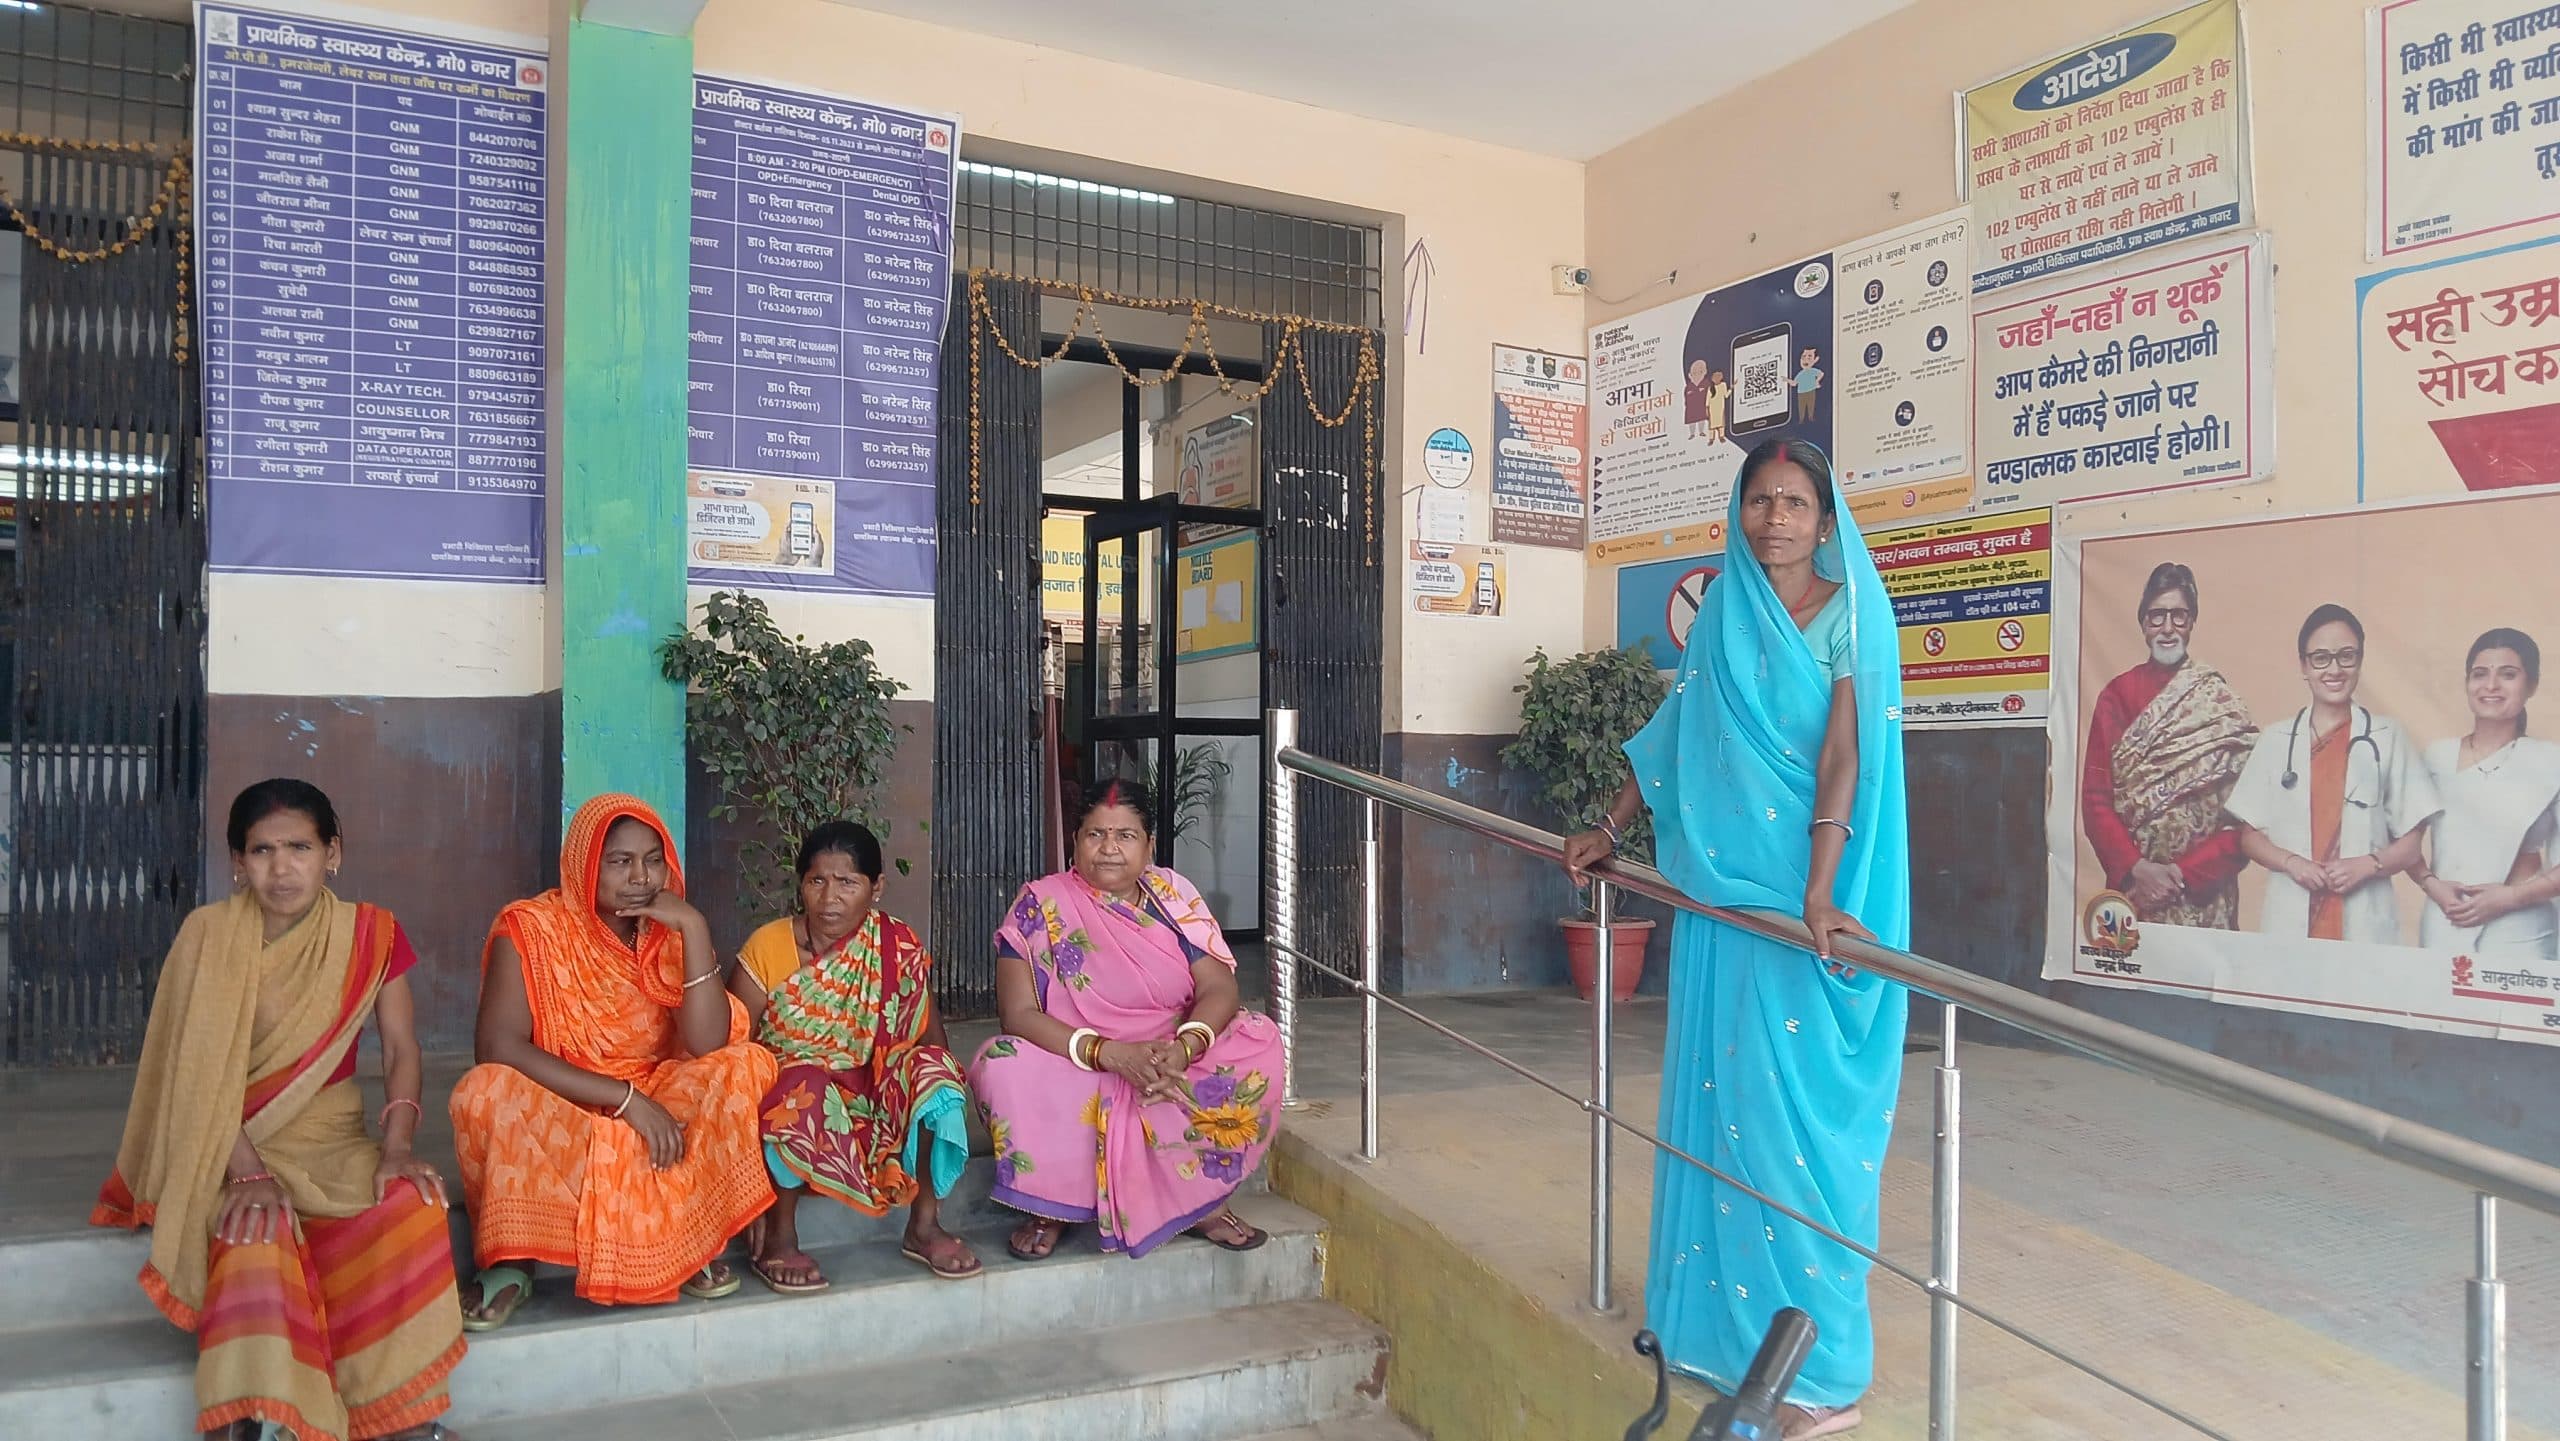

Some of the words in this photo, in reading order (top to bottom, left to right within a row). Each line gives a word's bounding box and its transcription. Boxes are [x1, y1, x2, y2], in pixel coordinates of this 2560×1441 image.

[246, 25, 318, 48] प्राथमिक
[322, 37, 382, 59] स्वास्थ्य
[471, 60, 511, 79] नगर
[2400, 32, 2453, 76] किसी
[2460, 22, 2486, 55] भी
[2042, 47, 2130, 105] आदेश
[2402, 82, 2422, 116] में
[2427, 68, 2481, 111] किसी
[2489, 57, 2515, 92] भी
[700, 89, 762, 112] प्राथमिक
[765, 97, 816, 122] स्वास्थ्य
[890, 123, 924, 141] नगर
[1972, 138, 1997, 161] सभी
[2001, 118, 2050, 153] आशाओं
[2055, 113, 2073, 133] को
[2078, 101, 2113, 126] निर्देश
[2119, 87, 2149, 112] दिया
[2154, 75, 2188, 99] जाता
[2192, 65, 2205, 86] है
[2210, 58, 2232, 81] कि
[389, 120, 420, 134] GNM
[2406, 124, 2436, 159] की
[2441, 113, 2484, 149] मांग
[2489, 101, 2522, 136] की
[1976, 164, 2003, 189] प्रसव
[2008, 158, 2020, 176] के
[2076, 134, 2093, 154] को
[2101, 126, 2129, 147] 102
[2192, 97, 2204, 117] से
[2211, 88, 2227, 111] ही
[299, 153, 323, 166] शर्मा
[389, 164, 420, 178] GNM
[768, 156, 784, 167] AM
[791, 159, 810, 171] 2:00
[811, 162, 826, 174] PM
[827, 166, 913, 190] (OPD-EMERGENCY)
[2019, 183, 2035, 200] घर
[2040, 176, 2051, 194] से
[2113, 152, 2127, 172] ले
[757, 170, 833, 192] OPD+Emergency
[769, 193, 793, 211] दिया
[872, 189, 899, 202] Dental
[901, 194, 921, 206] OPD
[1985, 221, 2010, 239] 102
[2065, 197, 2077, 216] से
[2081, 185, 2107, 210] नहीं
[2111, 179, 2139, 201] लाने
[2145, 173, 2161, 191] या
[2166, 166, 2181, 186] ले
[2187, 156, 2218, 179] जाने
[290, 219, 325, 233] कुमारी
[758, 210, 824, 228] (7632067800)
[914, 216, 933, 231] सिंह
[2001, 244, 2016, 261] पर
[2021, 226, 2070, 258] प्रोत्साहन
[2076, 218, 2104, 241] राशि
[2139, 193, 2184, 223] मिलेगी
[2209, 210, 2232, 226] नगर
[867, 226, 930, 245] (6299673257)
[388, 251, 419, 264] GNM
[262, 305, 296, 318] अलका
[300, 307, 324, 321] रानी
[1997, 285, 2128, 349] जहाँ-तहाँ
[2132, 288, 2158, 317] न
[2166, 261, 2229, 324] थूकें
[388, 317, 419, 330] GNM
[2386, 287, 2475, 352] सही
[395, 340, 412, 351] LT
[395, 362, 412, 374] LT
[1995, 369, 2033, 401] आप
[2038, 348, 2089, 389] कैमरे
[2093, 340, 2123, 378] की
[2127, 319, 2220, 371] निगरानी
[2418, 350, 2512, 408] सोच
[360, 381, 402, 395] X-RAY
[406, 384, 446, 398] TECH.
[789, 382, 812, 397] रिया
[1605, 380, 1655, 407] आभा
[293, 397, 325, 411] कुमार
[757, 396, 820, 413] (7677590011)
[1627, 389, 1675, 415] बनाओ
[2013, 404, 2034, 438] में
[2036, 399, 2056, 437] हैं
[2057, 390, 2109, 432] पकड़े
[2113, 379, 2162, 419] जाने
[2167, 381, 2199, 409] पर
[356, 403, 450, 420] COUNSELLOR
[289, 420, 321, 433] कुमार
[1613, 413, 1649, 430] डिजिटल
[360, 425, 416, 440] आयुष्मान
[420, 426, 446, 441] मित्र
[1600, 430, 1615, 446] हो
[357, 444, 389, 455] DATA
[390, 446, 453, 458] OPERATOR
[912, 444, 931, 459] सिंह
[1987, 448, 2078, 485] दण्डात्मक
[2083, 423, 2162, 466] कारवाई
[865, 458, 928, 473] (6299673257)
[366, 470, 402, 482] सफाई
[1933, 538, 1980, 557] तम्बाकू
[1982, 533, 2017, 555] मुक्त
[2020, 529, 2032, 546] है
[2480, 968, 2549, 991] सामुदायिक
